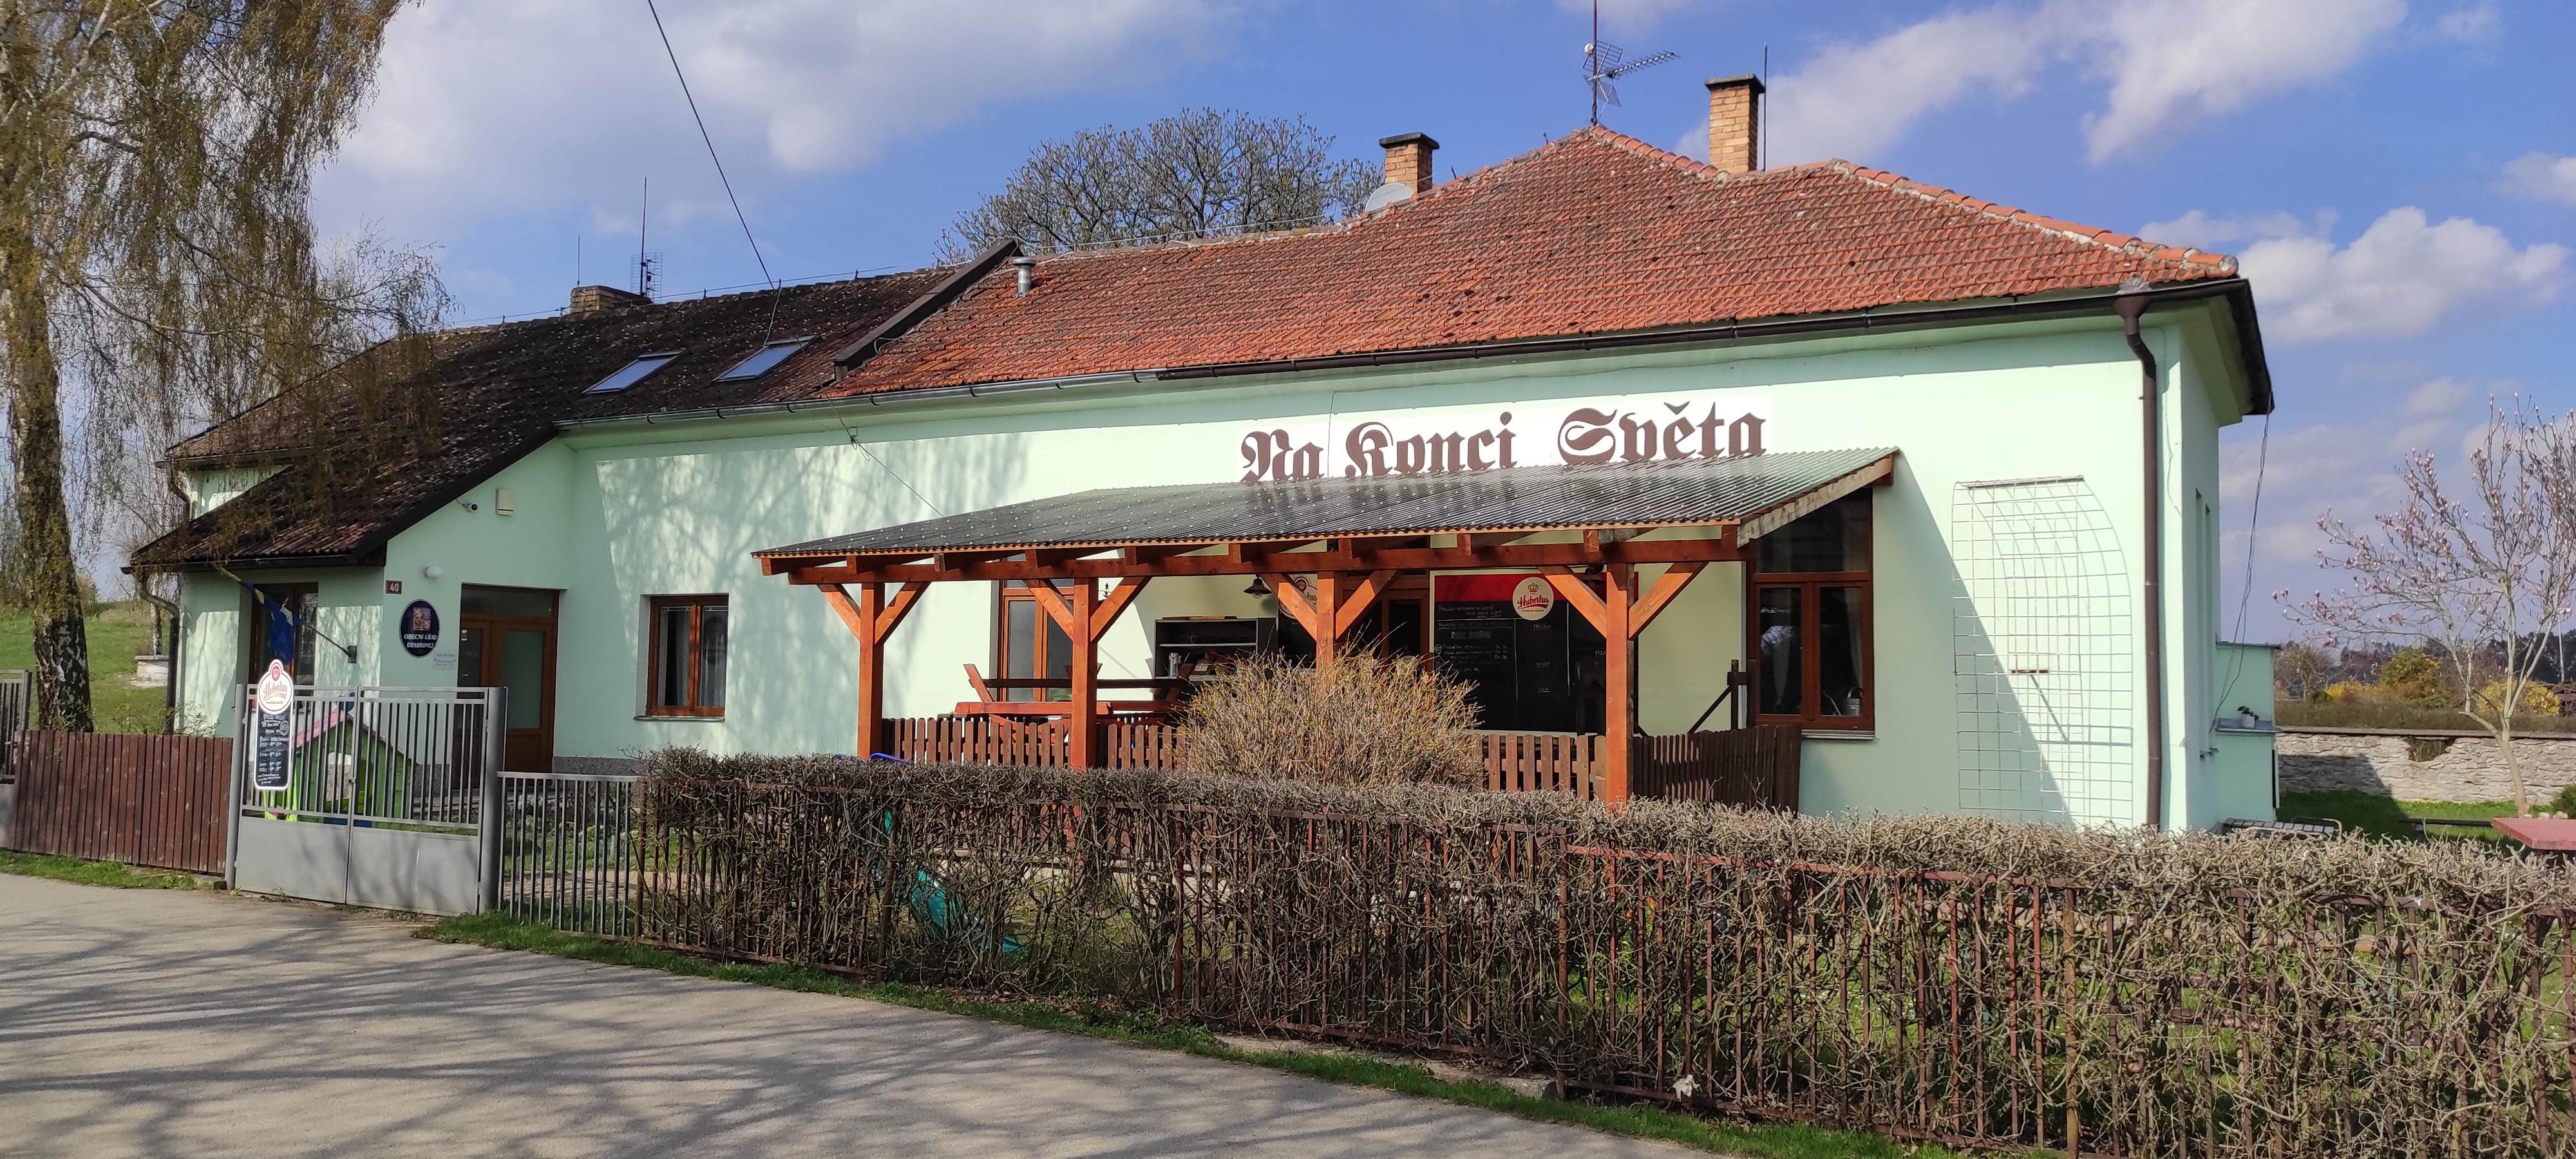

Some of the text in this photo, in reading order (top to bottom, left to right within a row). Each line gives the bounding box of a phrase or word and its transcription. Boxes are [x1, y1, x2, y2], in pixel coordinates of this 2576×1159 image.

[1240, 400, 1767, 484] Na Konci Světa
[390, 583, 399, 592] 40
[1517, 594, 1549, 607] Hubertus
